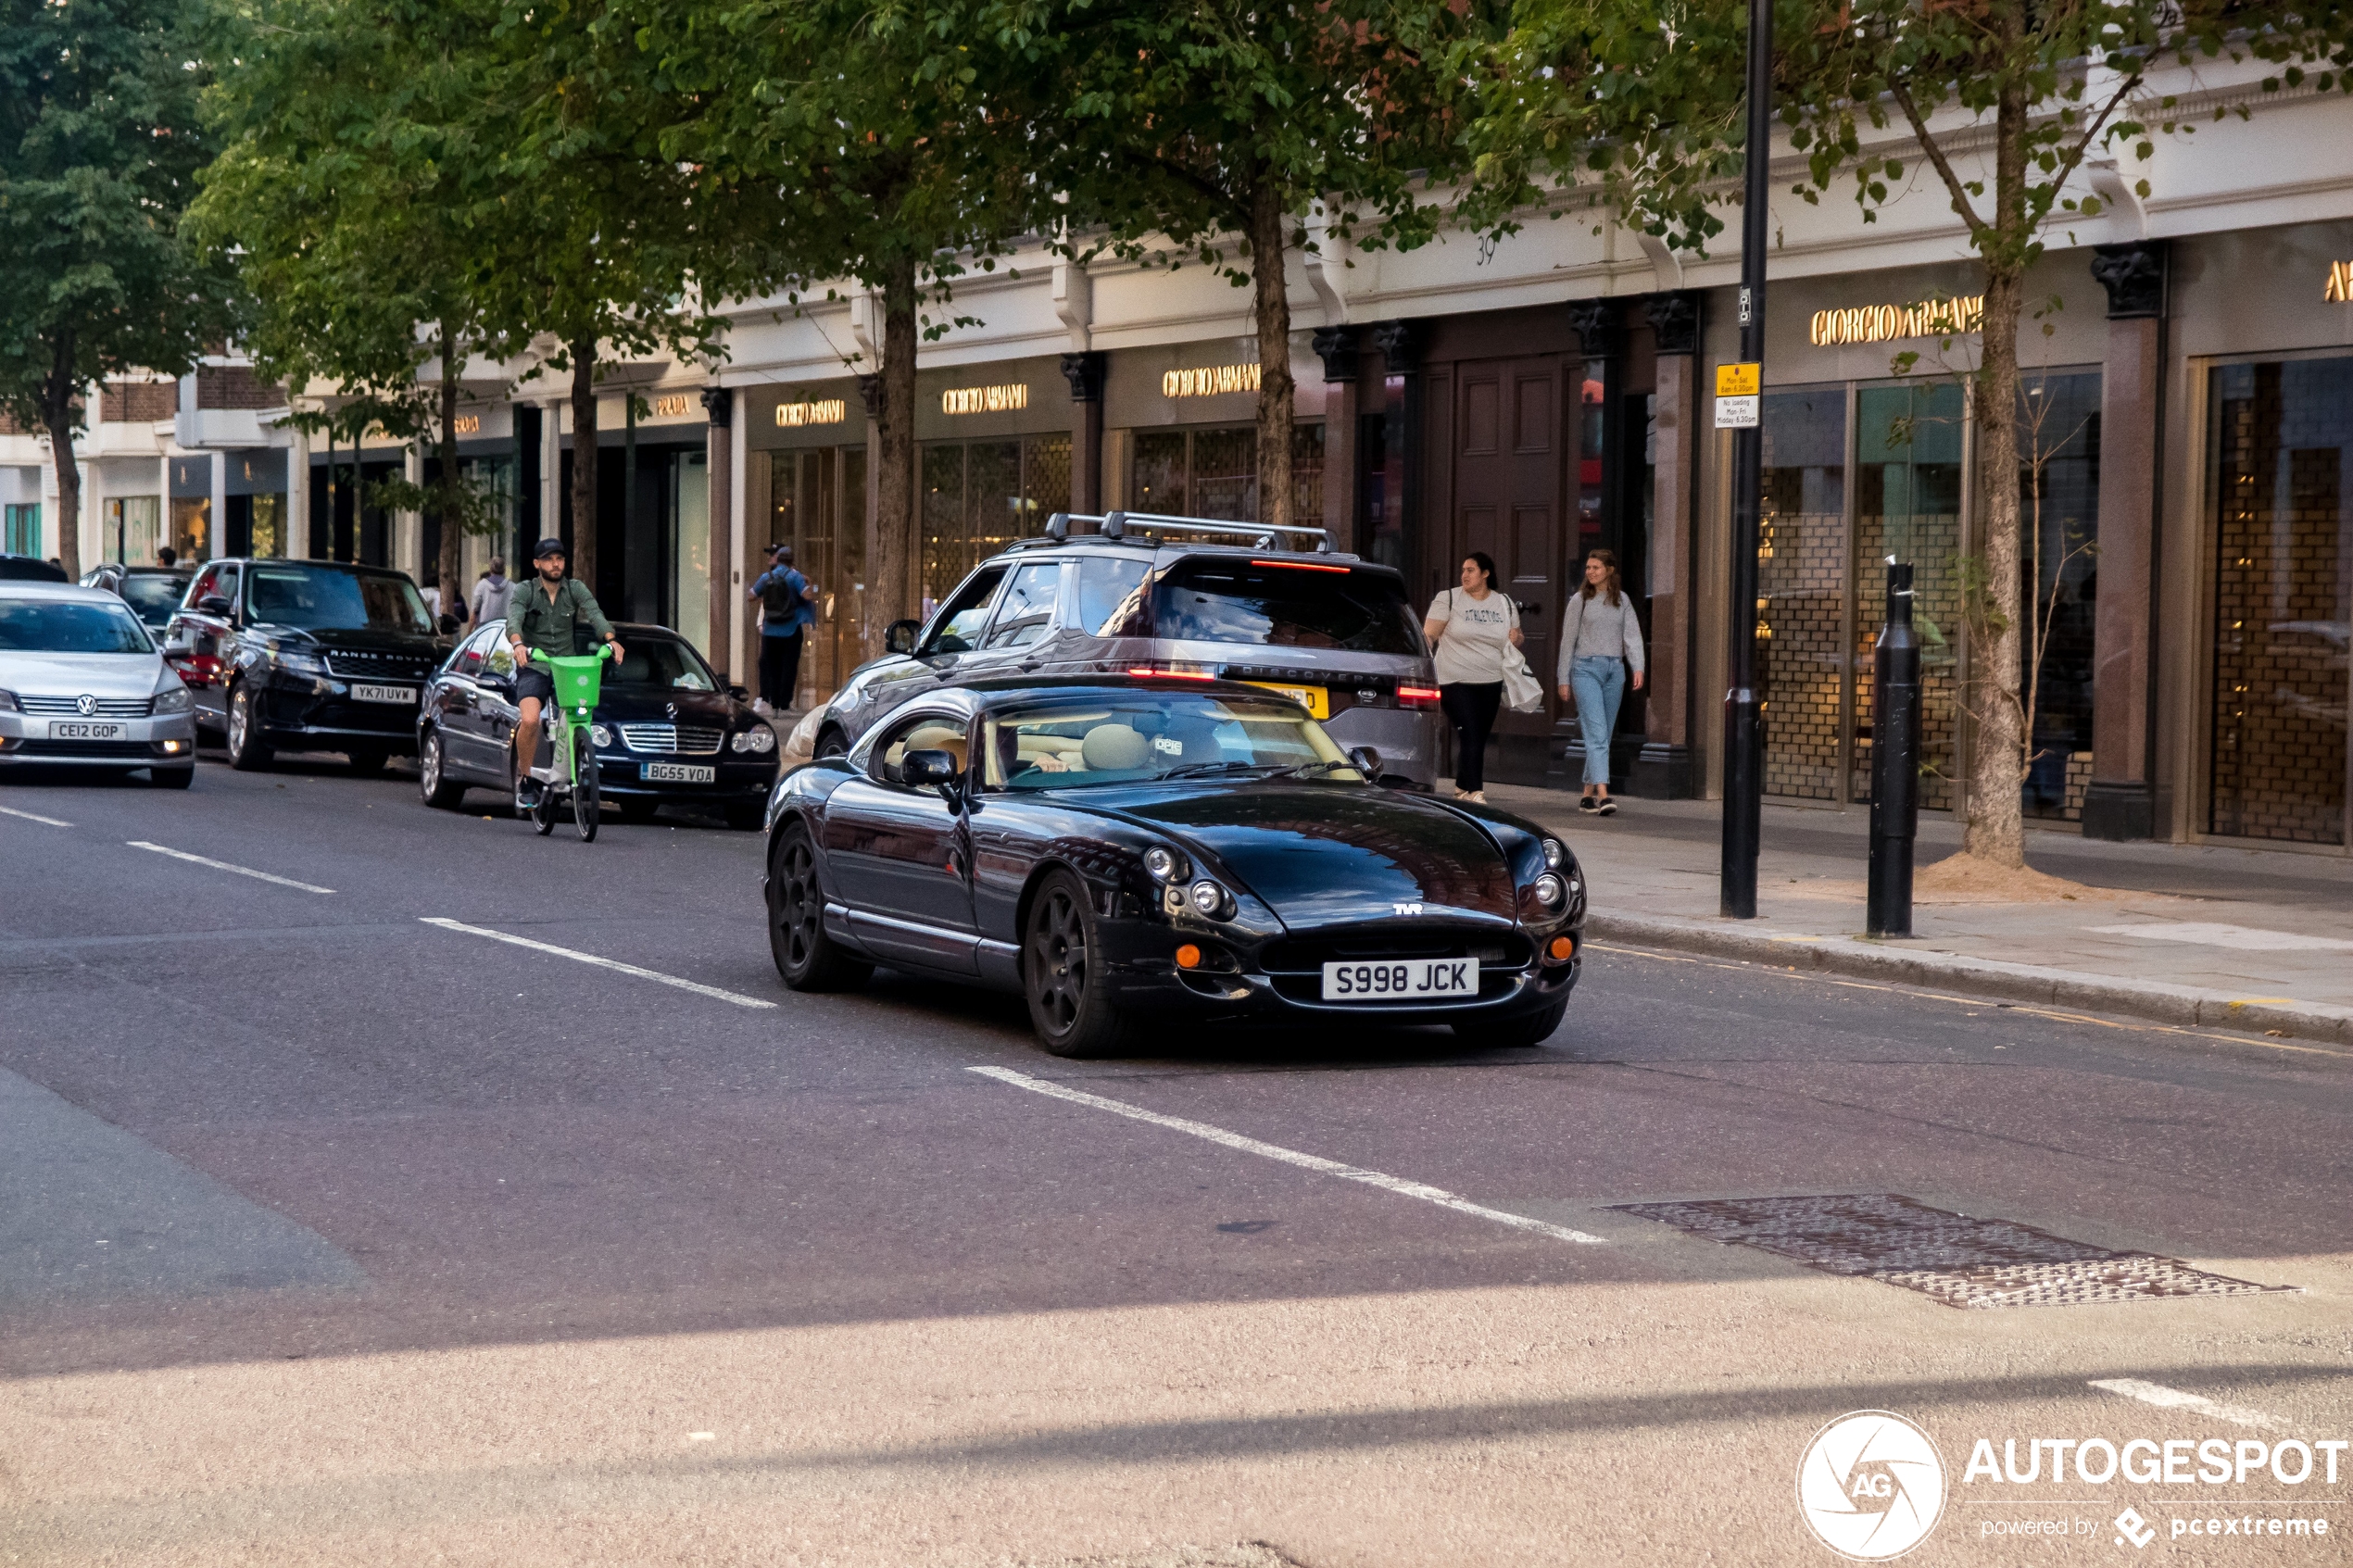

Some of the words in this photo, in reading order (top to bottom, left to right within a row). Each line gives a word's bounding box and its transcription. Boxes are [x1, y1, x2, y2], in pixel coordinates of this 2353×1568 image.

[1811, 304, 1900, 346] GIORGIO
[1163, 367, 1213, 398] GIORGIO
[657, 395, 690, 416] PRADA
[943, 387, 983, 414] GIORGIO
[983, 383, 1027, 411] ARMANI
[776, 402, 809, 426] GIORGIO
[809, 398, 845, 424] ARMANI
[330, 649, 378, 660] RANGE
[385, 654, 432, 662] ROVER
[1242, 666, 1379, 684] DISCOVERY
[359, 686, 385, 698] YK71
[387, 688, 410, 700] UVW
[59, 724, 90, 737] CE12
[93, 725, 119, 738] GOP
[650, 765, 686, 780] BG55
[688, 767, 712, 782] VOA
[1392, 903, 1424, 915] TVR
[1336, 965, 1408, 994] S998
[1416, 963, 1467, 991] JCK
